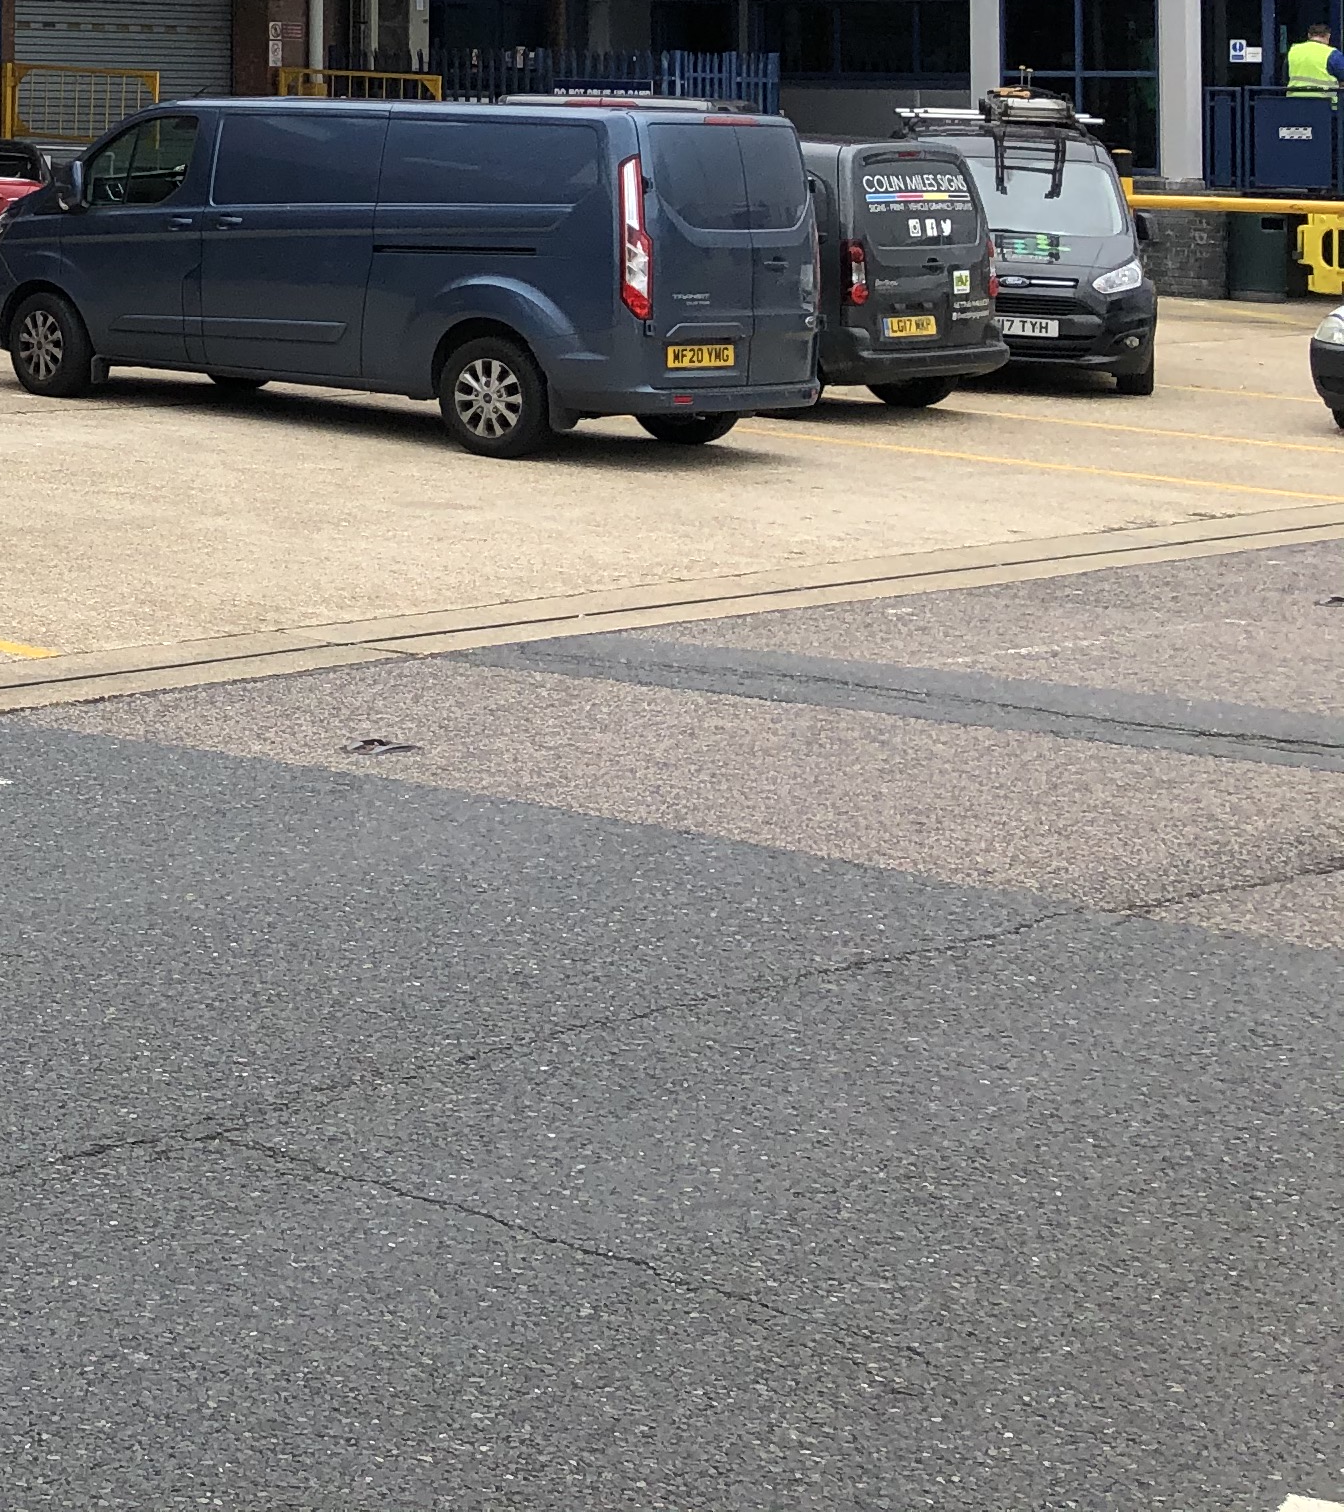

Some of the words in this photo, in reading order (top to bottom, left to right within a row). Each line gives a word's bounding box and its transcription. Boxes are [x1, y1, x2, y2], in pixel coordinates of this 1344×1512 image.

[862, 175, 906, 193] COLIN
[906, 174, 938, 192] MILES
[936, 174, 968, 191] SIGNS
[890, 318, 913, 334] LG17
[1018, 319, 1049, 334] TYH
[672, 347, 704, 364] MF20
[706, 346, 730, 363] YMG
